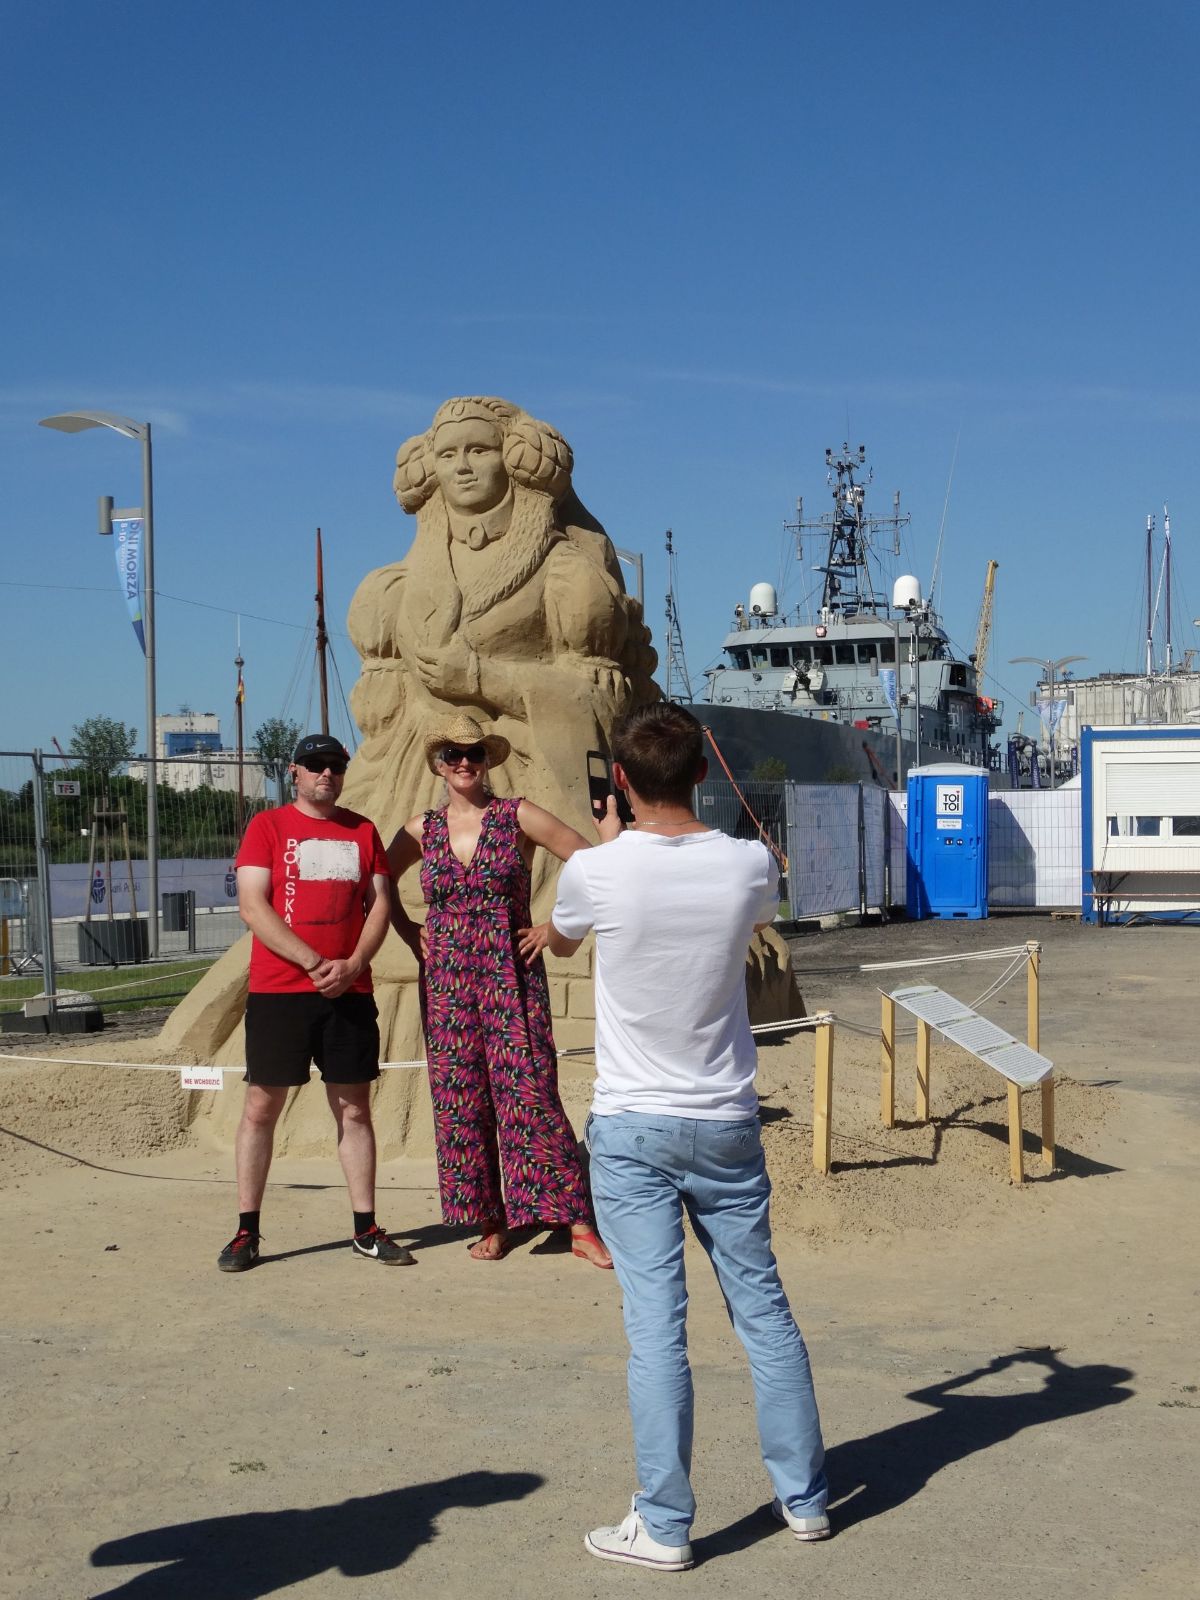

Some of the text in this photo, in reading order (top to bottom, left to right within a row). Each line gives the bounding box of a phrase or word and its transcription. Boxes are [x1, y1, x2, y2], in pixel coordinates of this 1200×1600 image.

[126, 521, 139, 600] DNI MORZA
[58, 784, 75, 794] TFS
[943, 803, 960, 811] TOI
[283, 838, 298, 927] POLSKA
